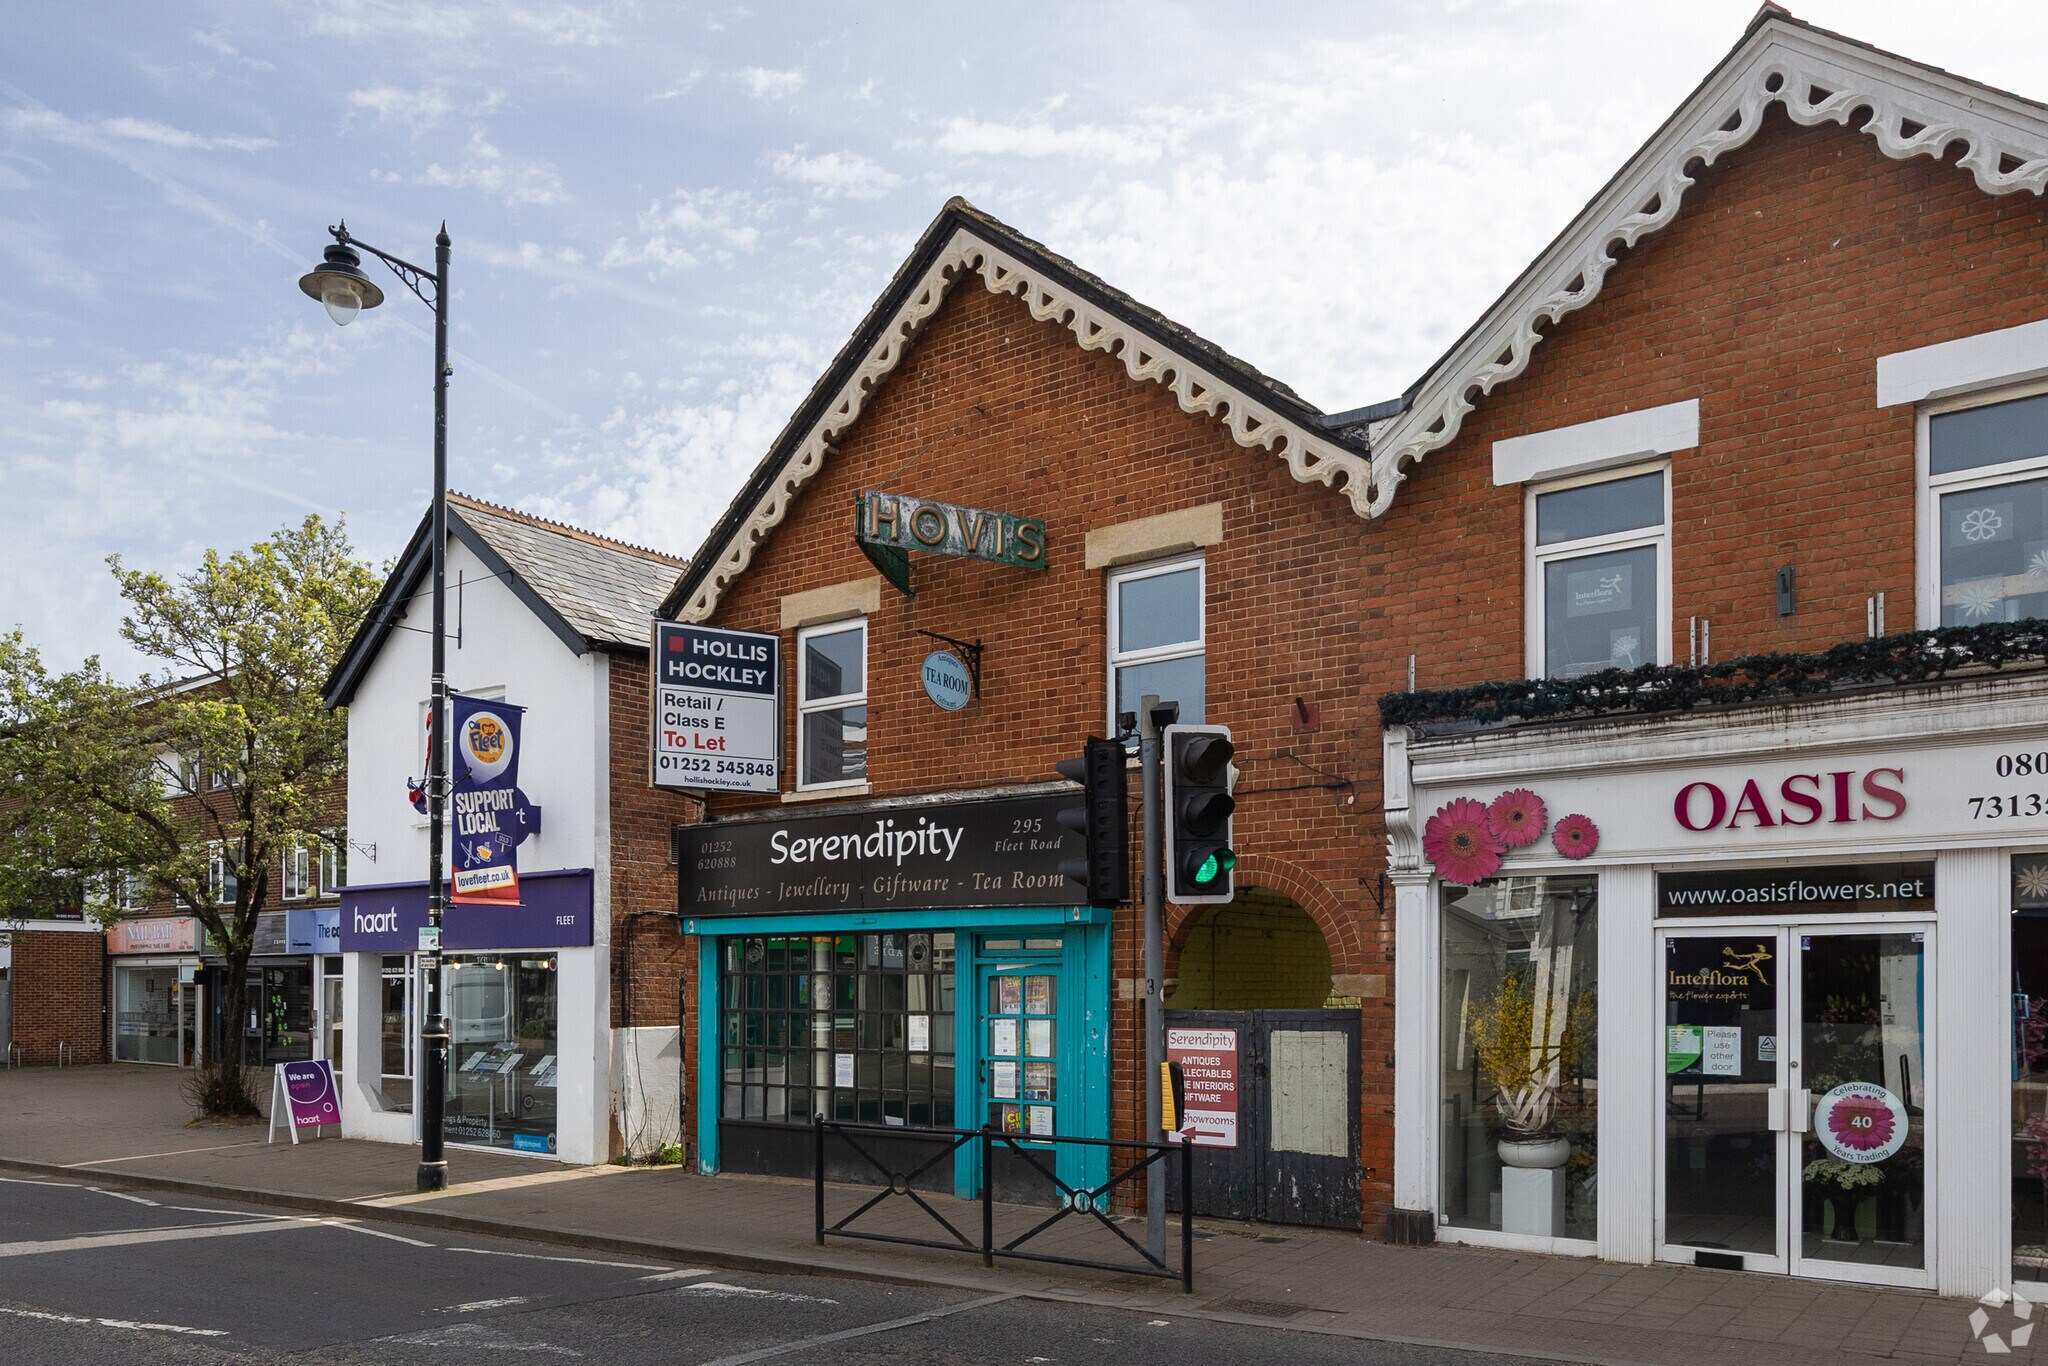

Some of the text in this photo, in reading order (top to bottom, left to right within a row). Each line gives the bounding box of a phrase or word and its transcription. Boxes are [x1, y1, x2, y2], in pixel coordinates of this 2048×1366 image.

[871, 497, 1041, 561] HOVIS
[1576, 589, 1612, 600] Interflora
[693, 639, 767, 662] HOLLIS
[669, 660, 767, 686] HOCKLEY
[925, 666, 969, 695] TEA ROOM
[664, 693, 711, 710] Retail
[664, 713, 725, 730] Class E
[664, 731, 725, 751] To Let
[660, 756, 774, 777] 01252 545848
[684, 776, 751, 788] hollishockley.co.uk
[455, 788, 514, 814] SUPPORT
[1673, 768, 1907, 832] OASIS
[1968, 794, 2048, 819] 7313
[458, 811, 501, 836] LOCAL
[1012, 818, 1042, 834] 295
[498, 835, 509, 843] SOLD
[771, 817, 964, 866] Serendipity
[994, 835, 1063, 852] Fleet Road
[701, 841, 733, 854] 01252
[697, 856, 737, 870] 620888
[457, 870, 510, 887] lovefleet.co.uk
[696, 885, 759, 907] Antiques
[778, 876, 850, 903] Jewellery
[873, 873, 950, 901] Giftware
[972, 872, 1002, 890] Tea
[1011, 870, 1065, 889] Room
[1668, 879, 1924, 905] www.oasisflowers.net
[354, 905, 398, 934] haart
[556, 915, 575, 926] FLEET
[128, 923, 173, 941] NAIL BAR
[318, 924, 331, 938] The
[1669, 970, 1749, 985] Interflora
[1147, 979, 1154, 995] 3
[1685, 991, 1713, 1000] flower
[1715, 991, 1748, 1003] experts
[1169, 1032, 1235, 1048] Serendipity
[1707, 1030, 1737, 1038] Please
[1181, 1056, 1221, 1066] ANTIQUES
[1710, 1052, 1734, 1060] other
[1712, 1063, 1733, 1071] door
[288, 1073, 301, 1081] We
[291, 1082, 310, 1090] open
[1193, 1081, 1235, 1092] INTERIORS
[1833, 1084, 1887, 1098] Celebrating
[296, 1114, 321, 1125] haart
[1851, 1116, 1873, 1128] 40
[459, 1127, 476, 1137] 01252
[478, 1128, 501, 1139] 62860
[1833, 1145, 1890, 1161] Years Trading
